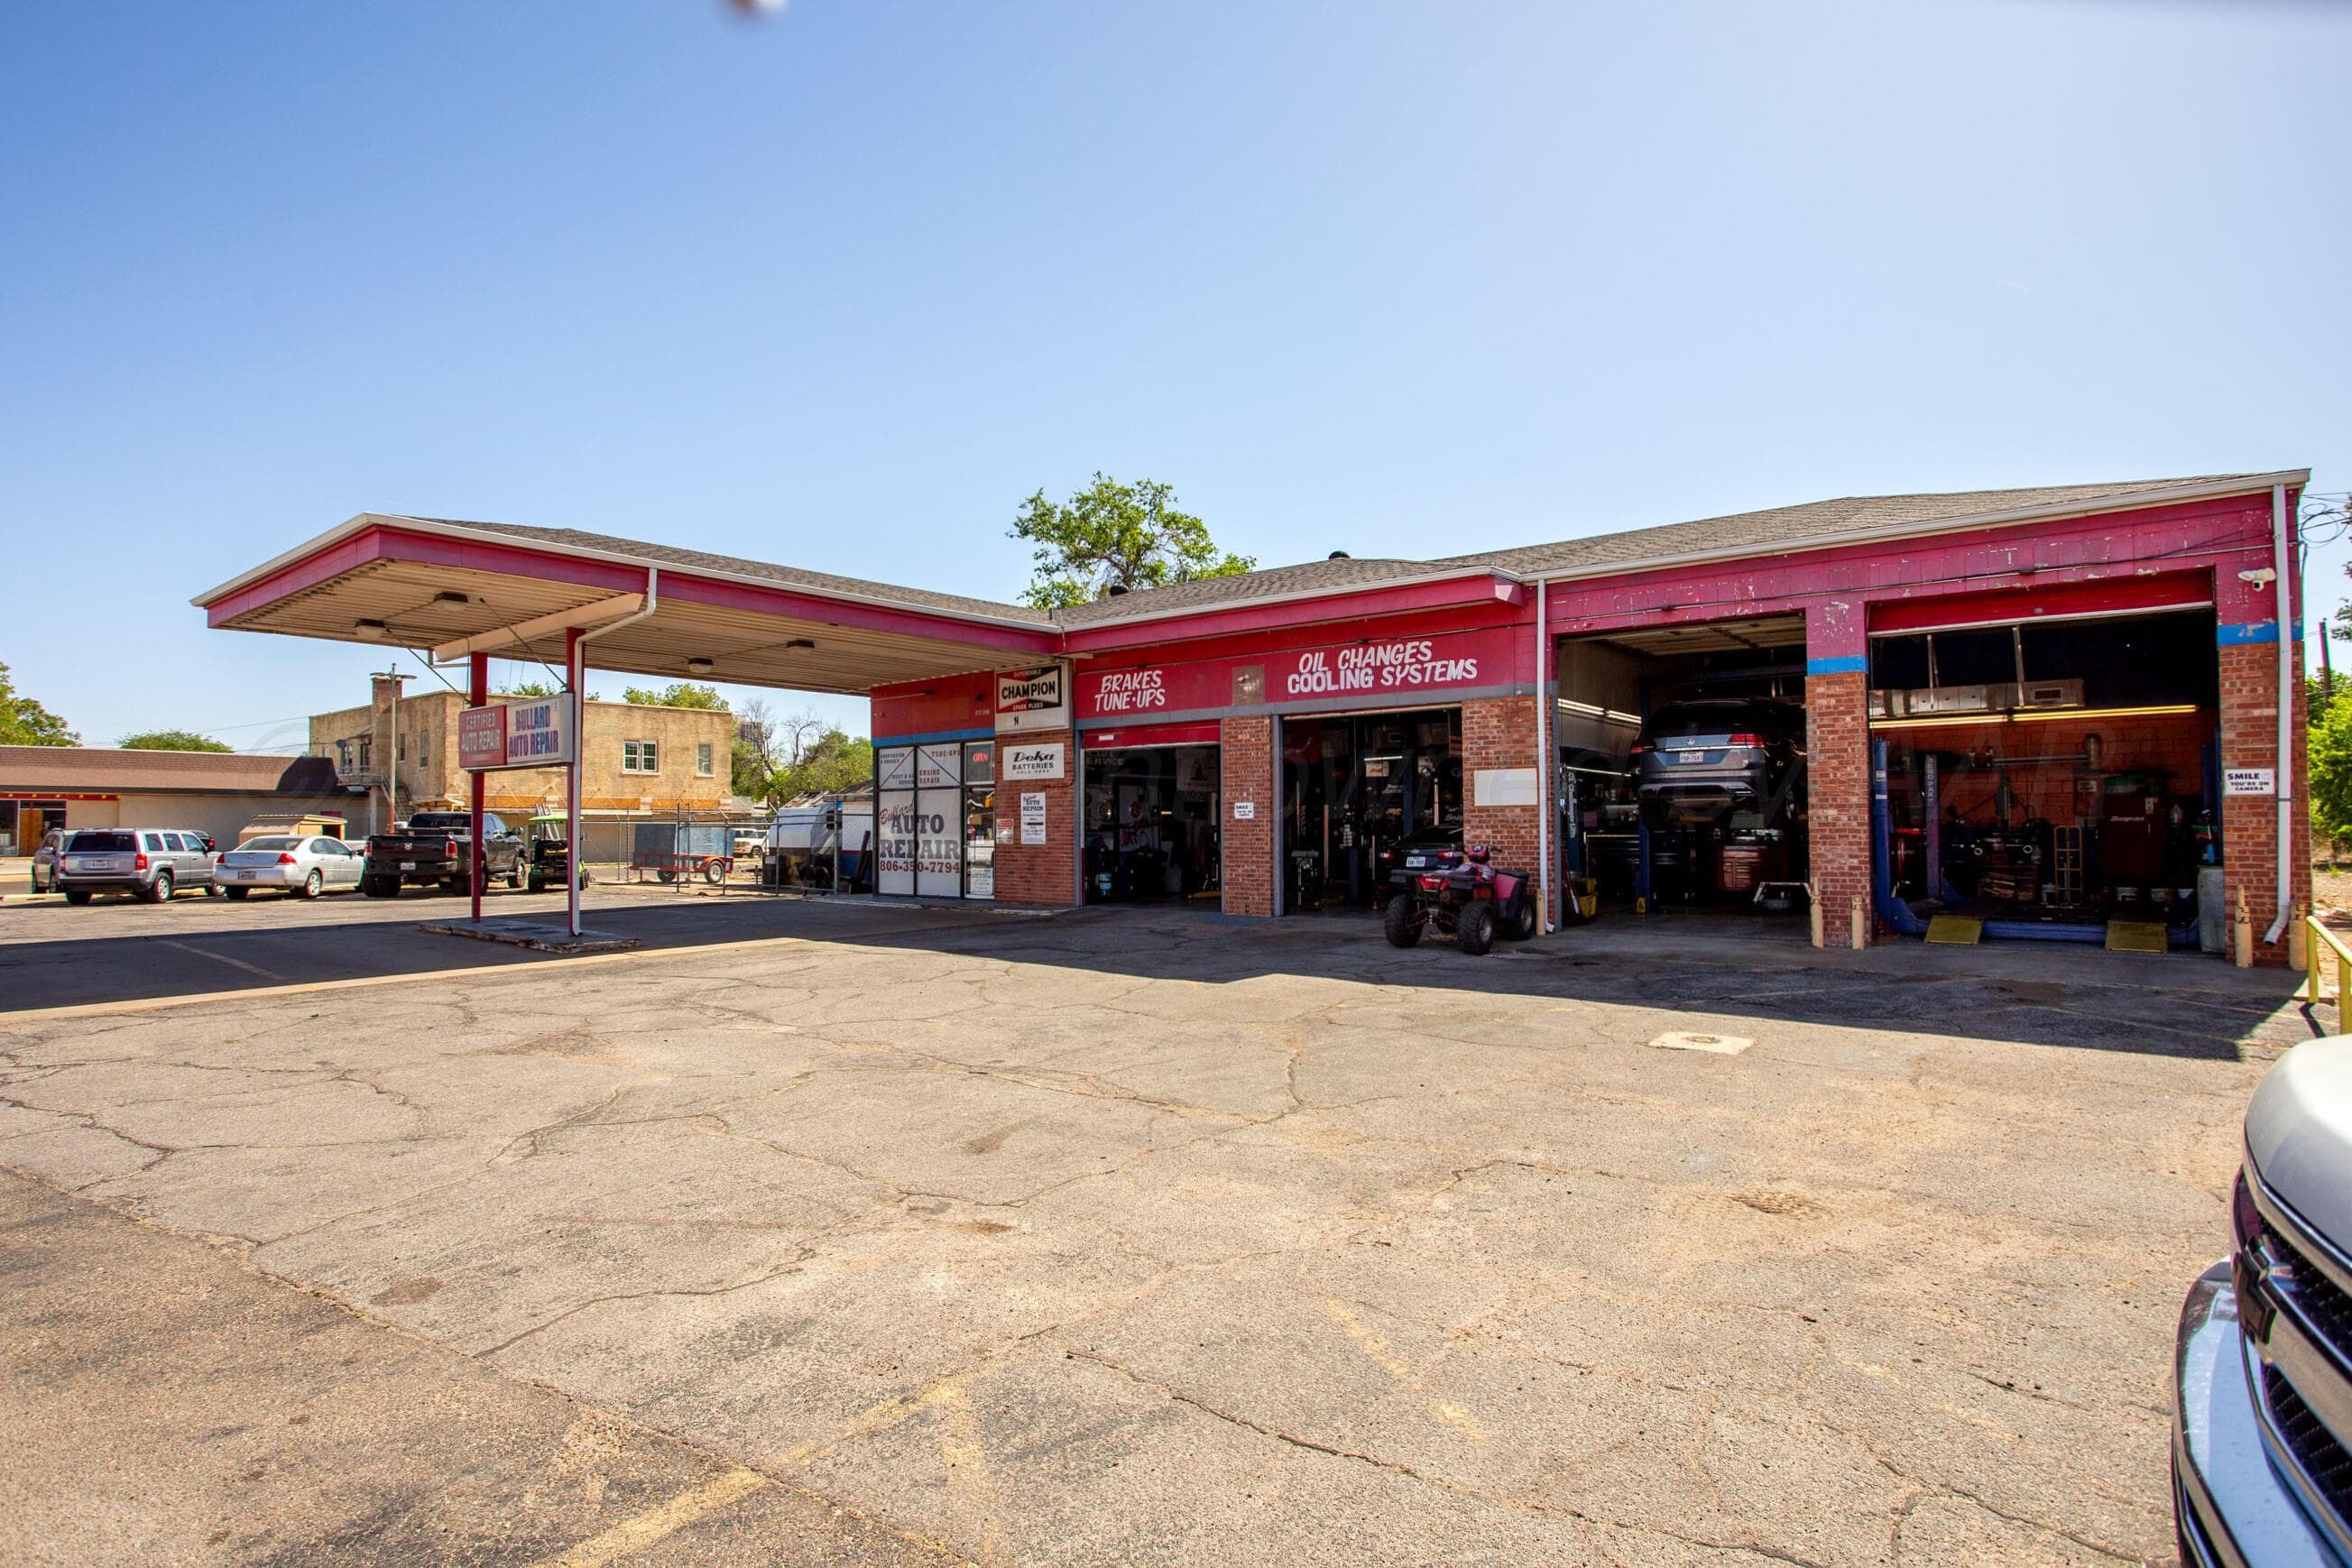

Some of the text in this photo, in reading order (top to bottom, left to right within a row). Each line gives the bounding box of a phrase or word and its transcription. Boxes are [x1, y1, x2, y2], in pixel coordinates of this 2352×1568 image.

[1298, 641, 1433, 672] OIL CHANGES
[1101, 669, 1163, 694] BRAKES
[1287, 659, 1478, 694] COOLING SYSTEMS
[1001, 680, 1056, 699] CHAMPION
[466, 712, 495, 730] CERTIFIED
[515, 705, 551, 732] BULLARD
[461, 729, 501, 752] AUTO REPAIR
[509, 730, 558, 758] AUTO REPAIR
[973, 752, 989, 762] OPEN
[1012, 751, 1055, 762] Deka
[1012, 762, 1054, 770] BATTERIES
[2227, 772, 2260, 780] SMILE
[890, 814, 945, 834] AUTO
[880, 839, 961, 860] REPAIR
[880, 860, 961, 874] 806-350-7794
